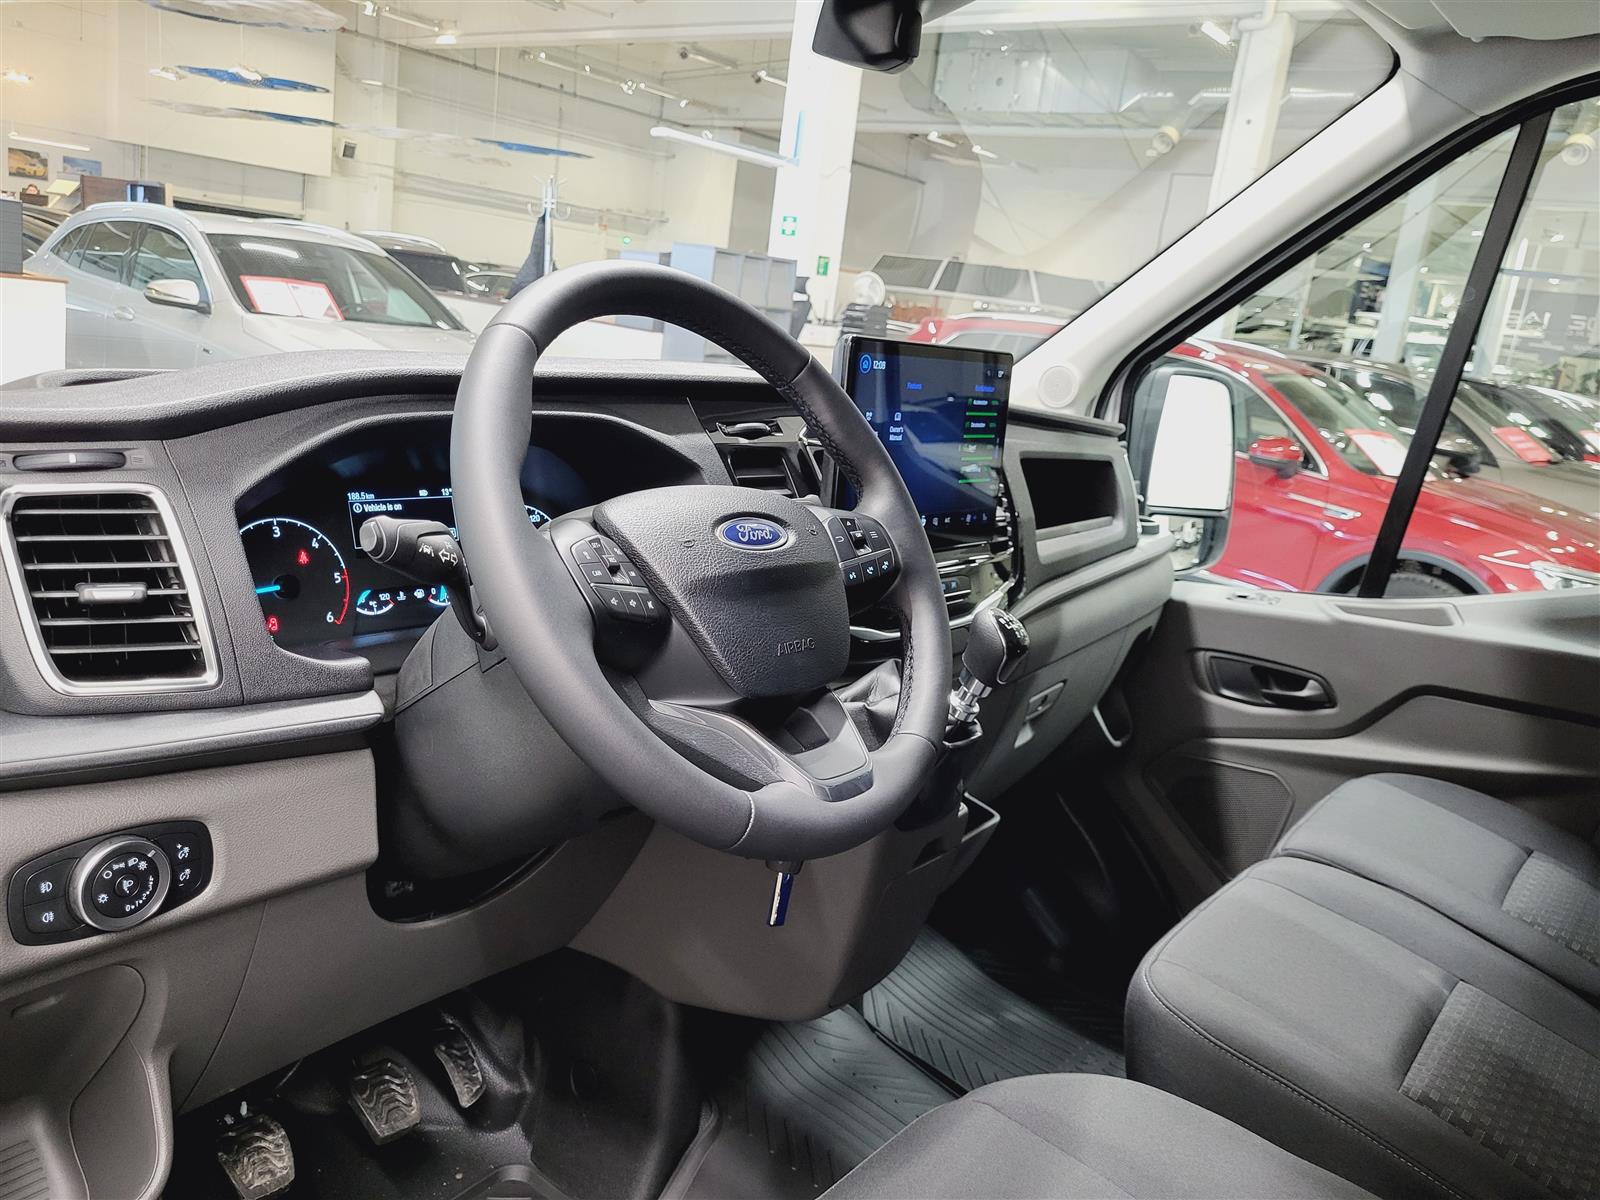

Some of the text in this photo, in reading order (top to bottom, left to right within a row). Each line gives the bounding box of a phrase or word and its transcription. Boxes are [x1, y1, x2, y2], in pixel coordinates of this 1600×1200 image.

[347, 492, 366, 500] 188.5
[363, 503, 402, 512] Vehicle is on
[272, 526, 281, 538] 3
[736, 523, 774, 542] Ford
[311, 537, 320, 549] 4
[333, 572, 342, 584] 5
[379, 592, 391, 601] 120
[326, 611, 335, 623] 6
[777, 637, 816, 657] AIRBAG
